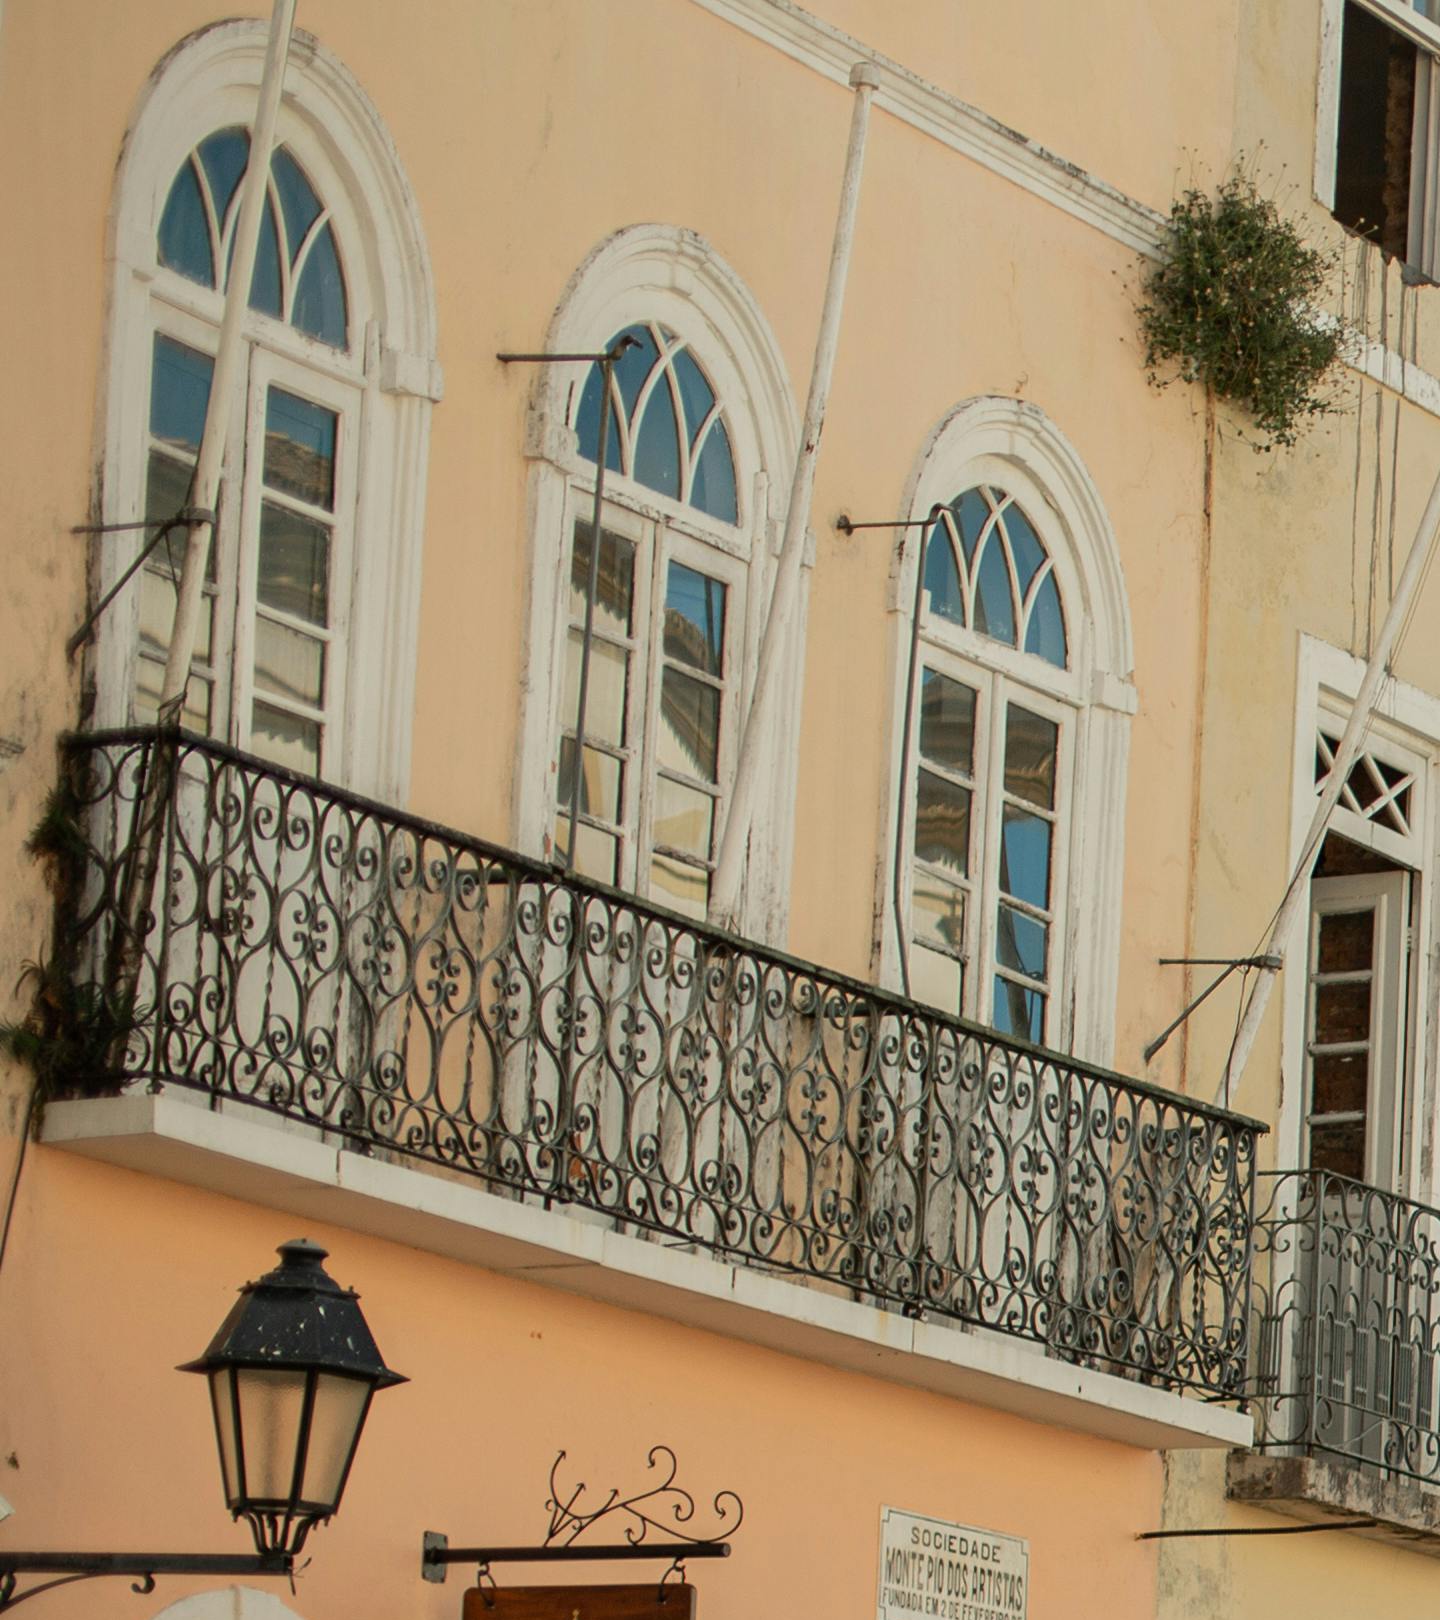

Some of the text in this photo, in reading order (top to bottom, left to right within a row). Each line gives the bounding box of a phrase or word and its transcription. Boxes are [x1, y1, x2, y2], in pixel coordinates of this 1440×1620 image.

[911, 1526, 1001, 1563] SOCIEDADE
[885, 1546, 1023, 1612] MONTE PIO DOS ARTISTAS
[882, 1587, 924, 1612] FUNDADA
[925, 1596, 939, 1617] EM
[940, 1599, 947, 1617] 2
